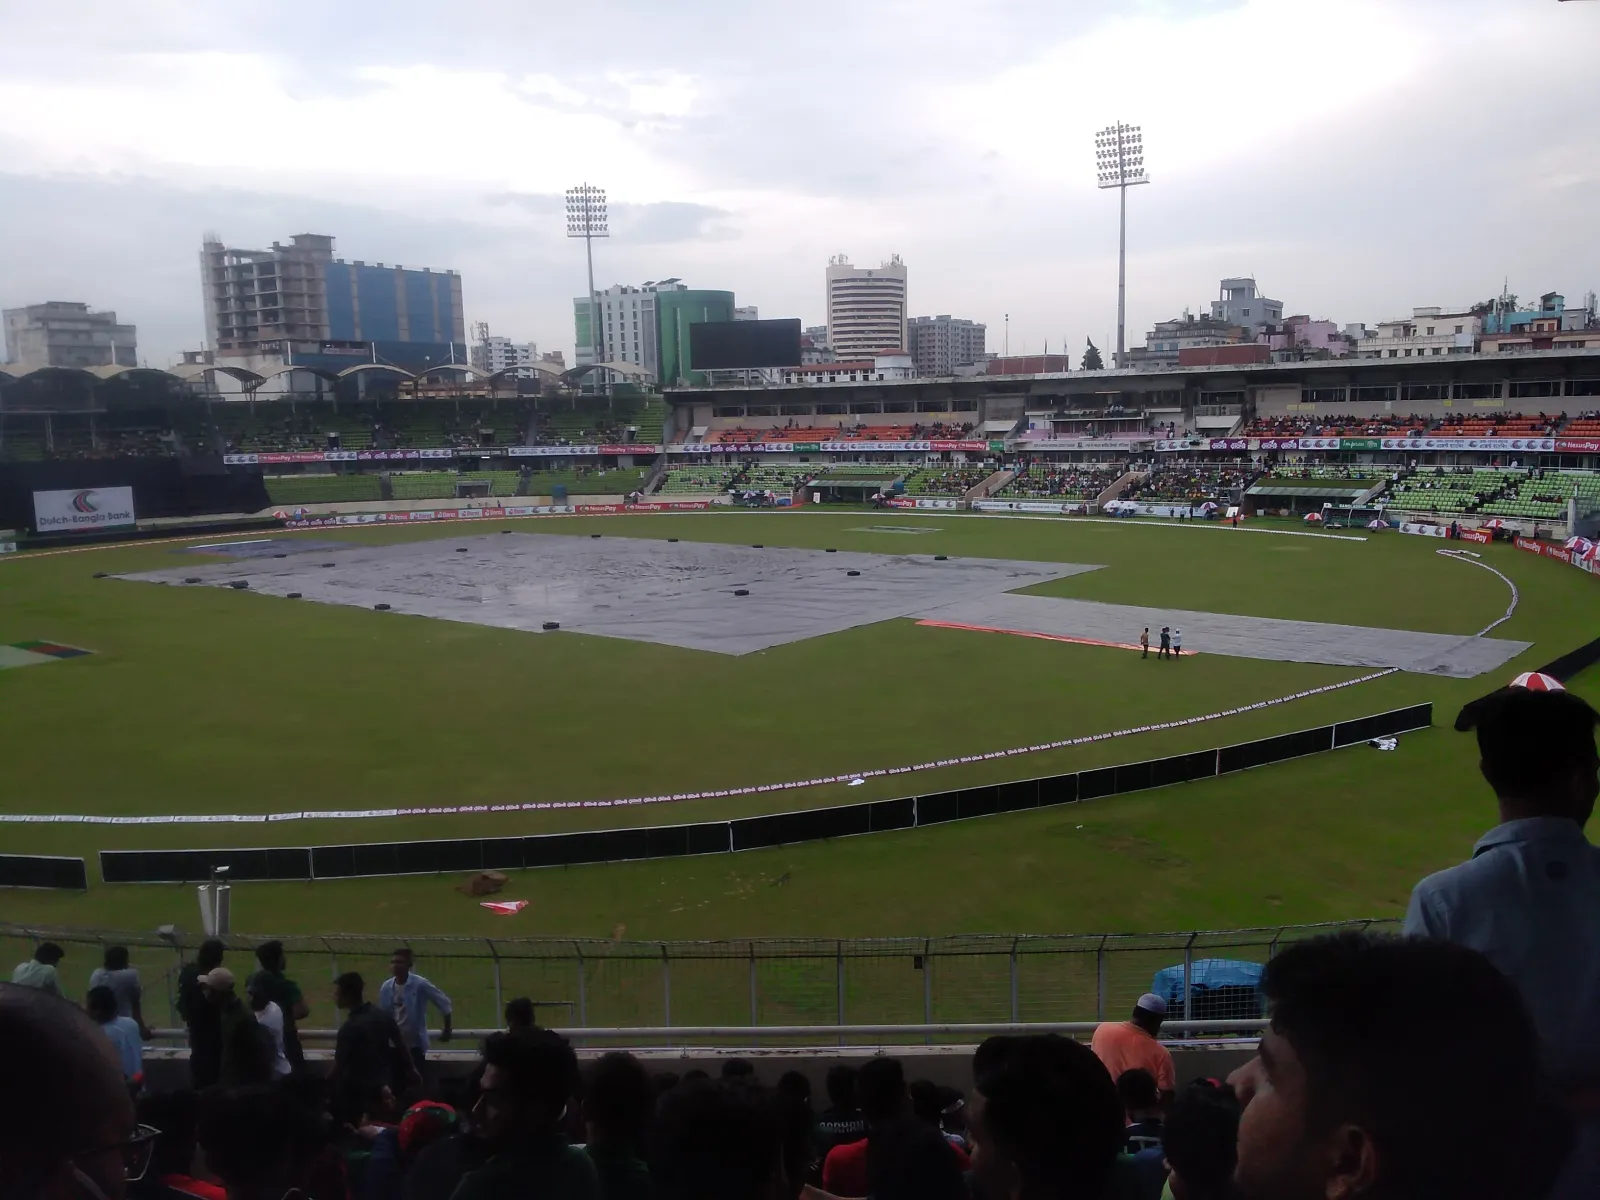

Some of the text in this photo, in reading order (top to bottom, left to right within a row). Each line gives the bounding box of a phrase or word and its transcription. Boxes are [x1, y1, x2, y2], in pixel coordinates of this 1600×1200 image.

[1567, 442, 1599, 451] NexusPay
[39, 511, 131, 525] Dutch-Bangla Bank
